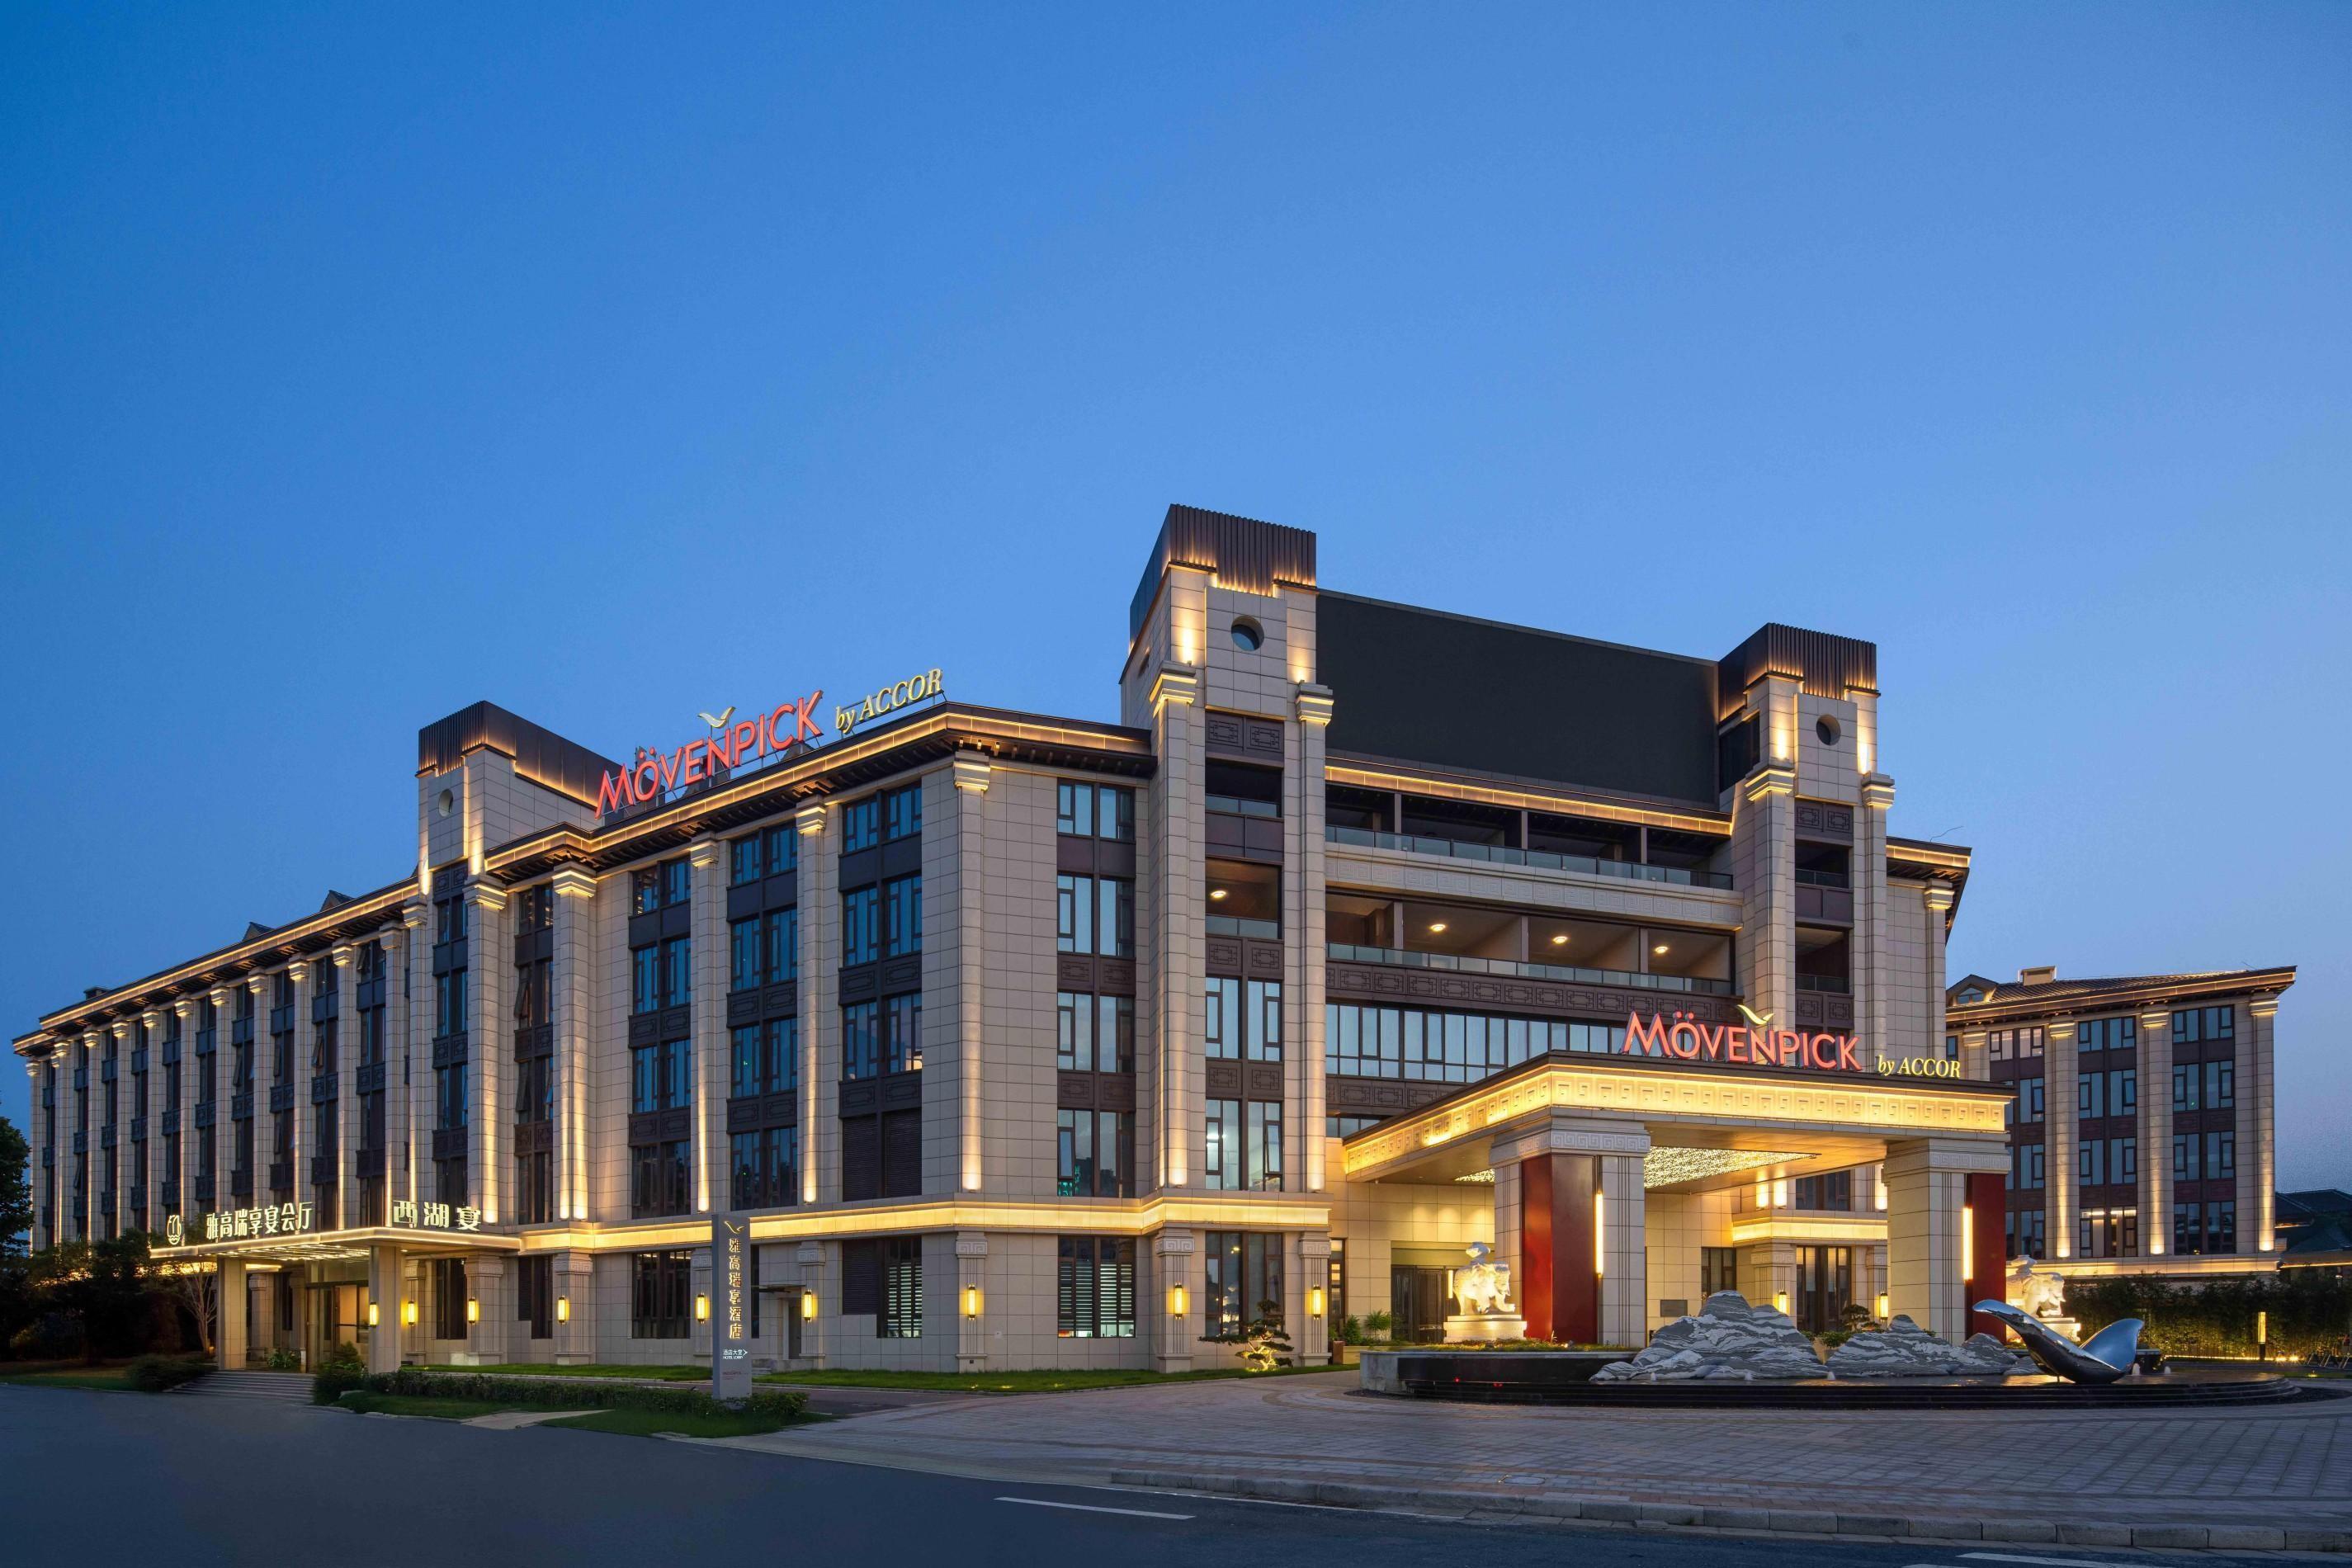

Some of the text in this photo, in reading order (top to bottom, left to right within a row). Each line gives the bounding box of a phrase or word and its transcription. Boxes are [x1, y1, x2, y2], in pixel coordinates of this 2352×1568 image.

[594, 668, 943, 819] MÖVENPICK by ACCOR
[1621, 1010, 1961, 1079] MÖVENPICK by ACCOR
[205, 1202, 314, 1240] 雅高瑞享宴会厅
[393, 1200, 482, 1231] 西湖宴
[729, 1238, 743, 1339] 雅高瑞享酒店
